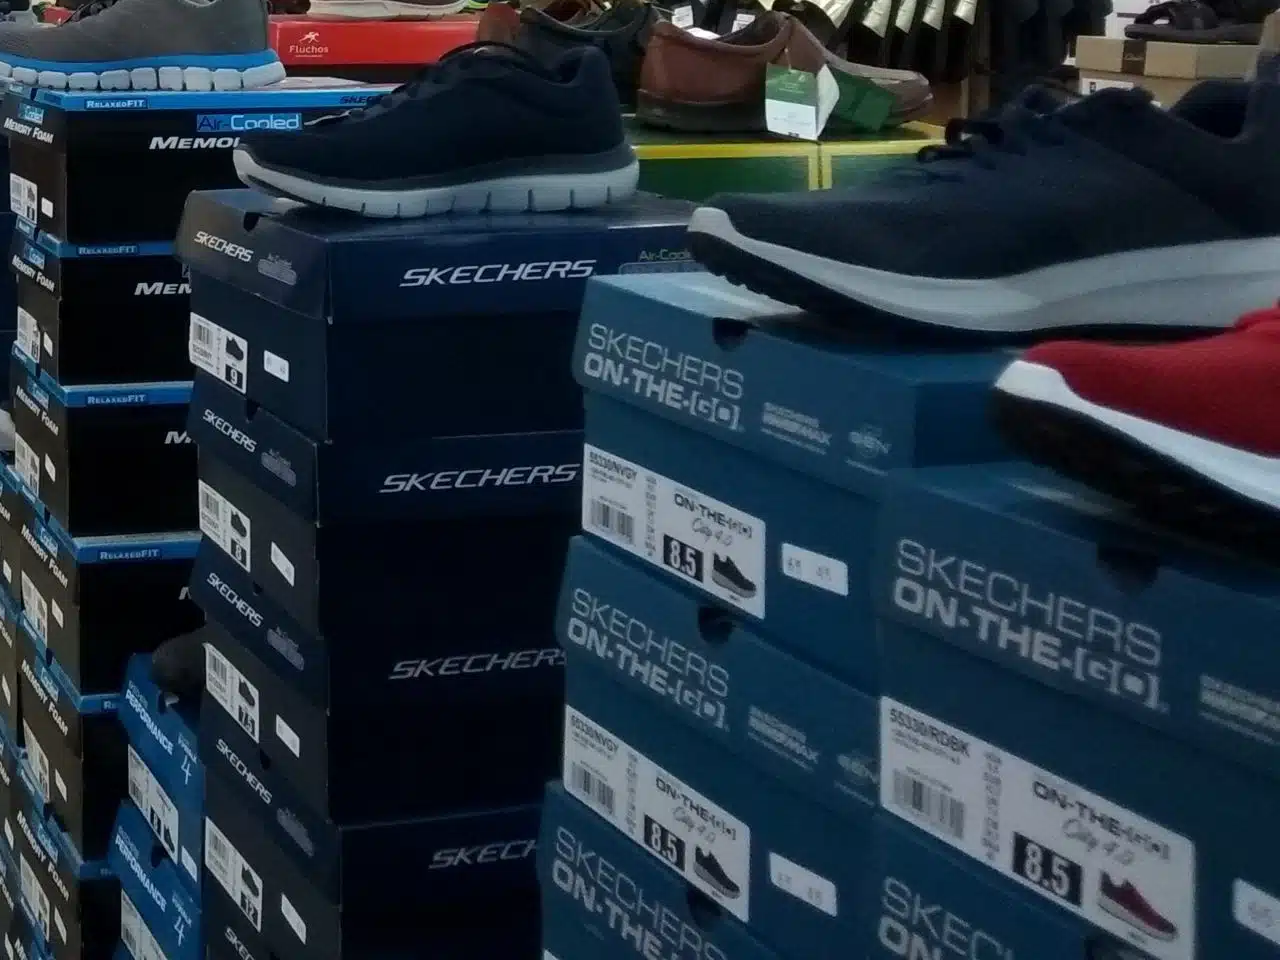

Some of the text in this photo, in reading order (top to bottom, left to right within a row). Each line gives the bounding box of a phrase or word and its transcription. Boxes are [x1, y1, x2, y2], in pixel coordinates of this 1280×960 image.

[289, 44, 329, 54] Fluchos
[149, 136, 241, 150] MEMO
[194, 230, 255, 263] SKECHERS
[400, 259, 598, 288] SKECHERS
[229, 369, 239, 386] 9
[587, 323, 745, 401] SKECHERS
[202, 408, 258, 454] SKECHERS
[379, 463, 581, 494] SKECHERS
[669, 539, 698, 578] 8.5
[206, 572, 264, 628] SKECHERS
[895, 537, 1163, 668] SKECHERS
[571, 587, 730, 698] SKECHERS
[215, 737, 273, 805] SKECHERS
[650, 822, 679, 865] 8.5
[1023, 841, 1074, 899] 8.5
